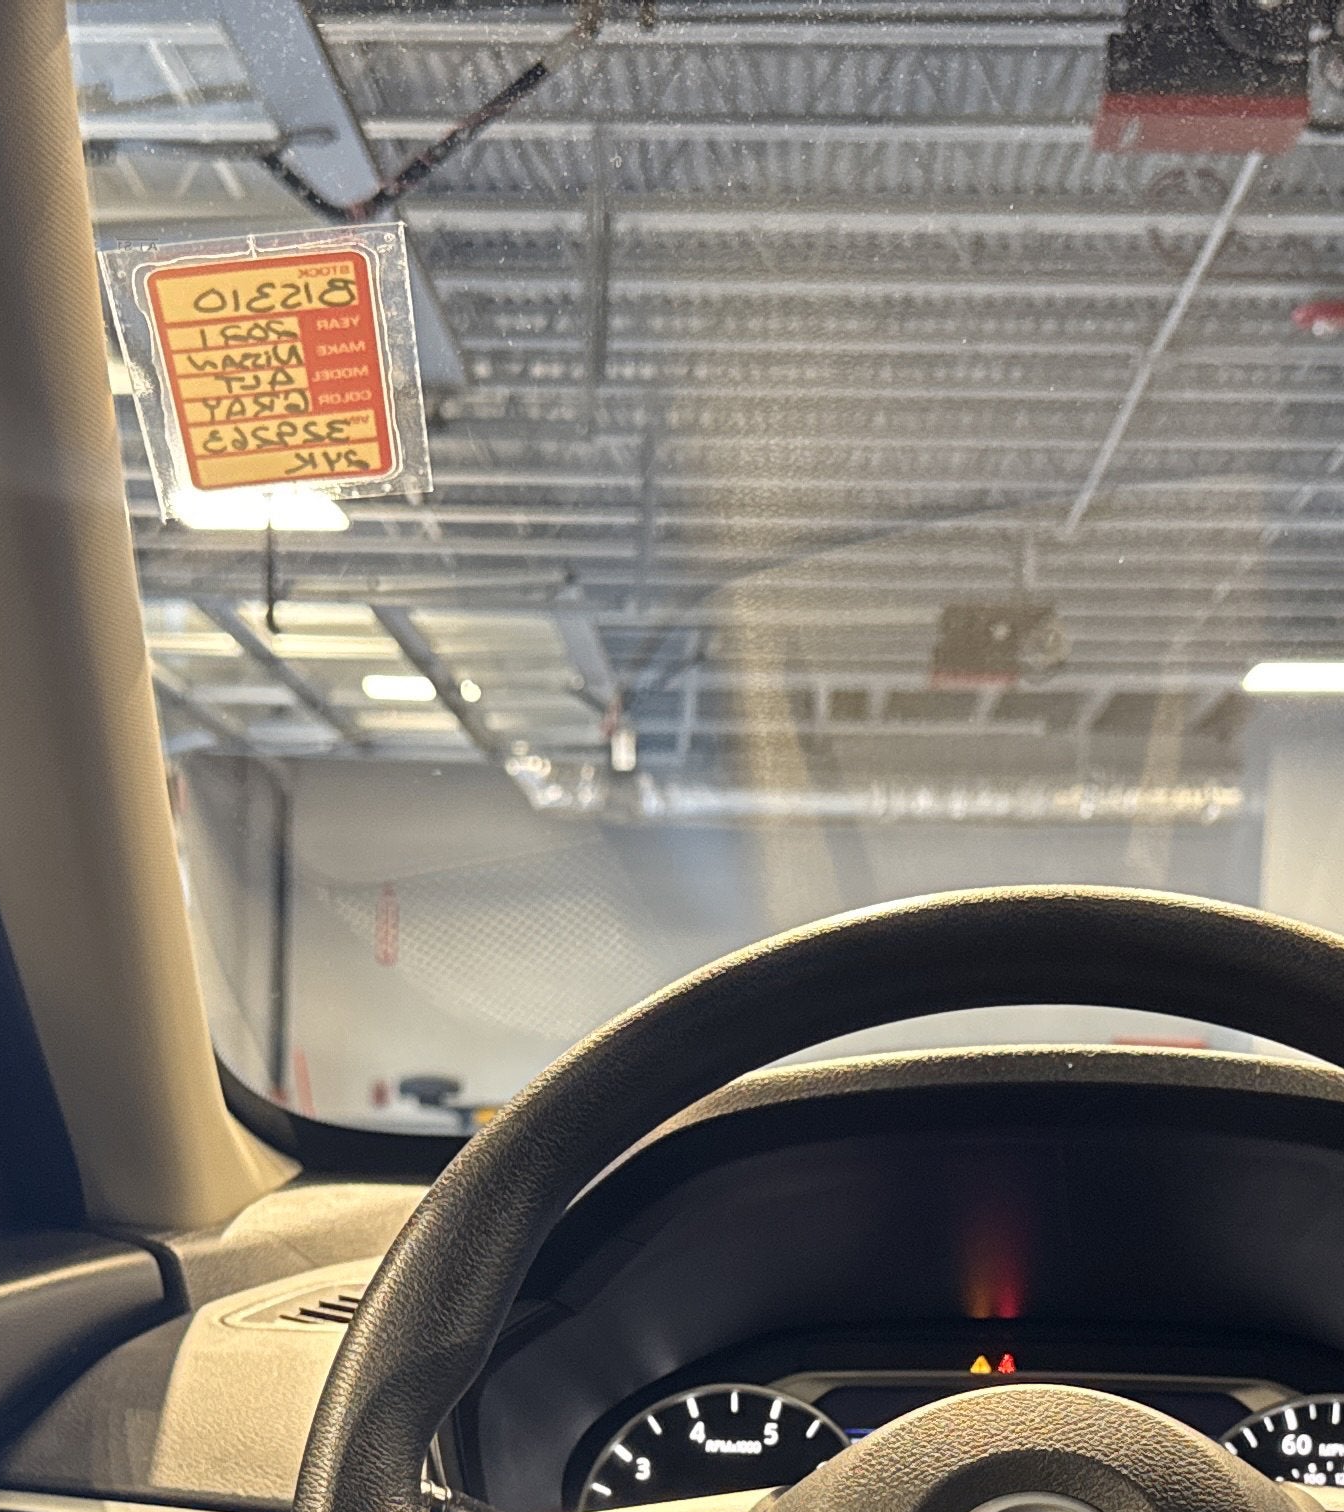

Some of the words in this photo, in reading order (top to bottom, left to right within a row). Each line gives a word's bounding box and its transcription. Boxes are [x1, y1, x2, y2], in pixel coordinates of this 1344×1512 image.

[689, 1420, 706, 1444] 4
[763, 1421, 779, 1446] 5
[1281, 1433, 1313, 1456] 60
[634, 1456, 651, 1481] 3
